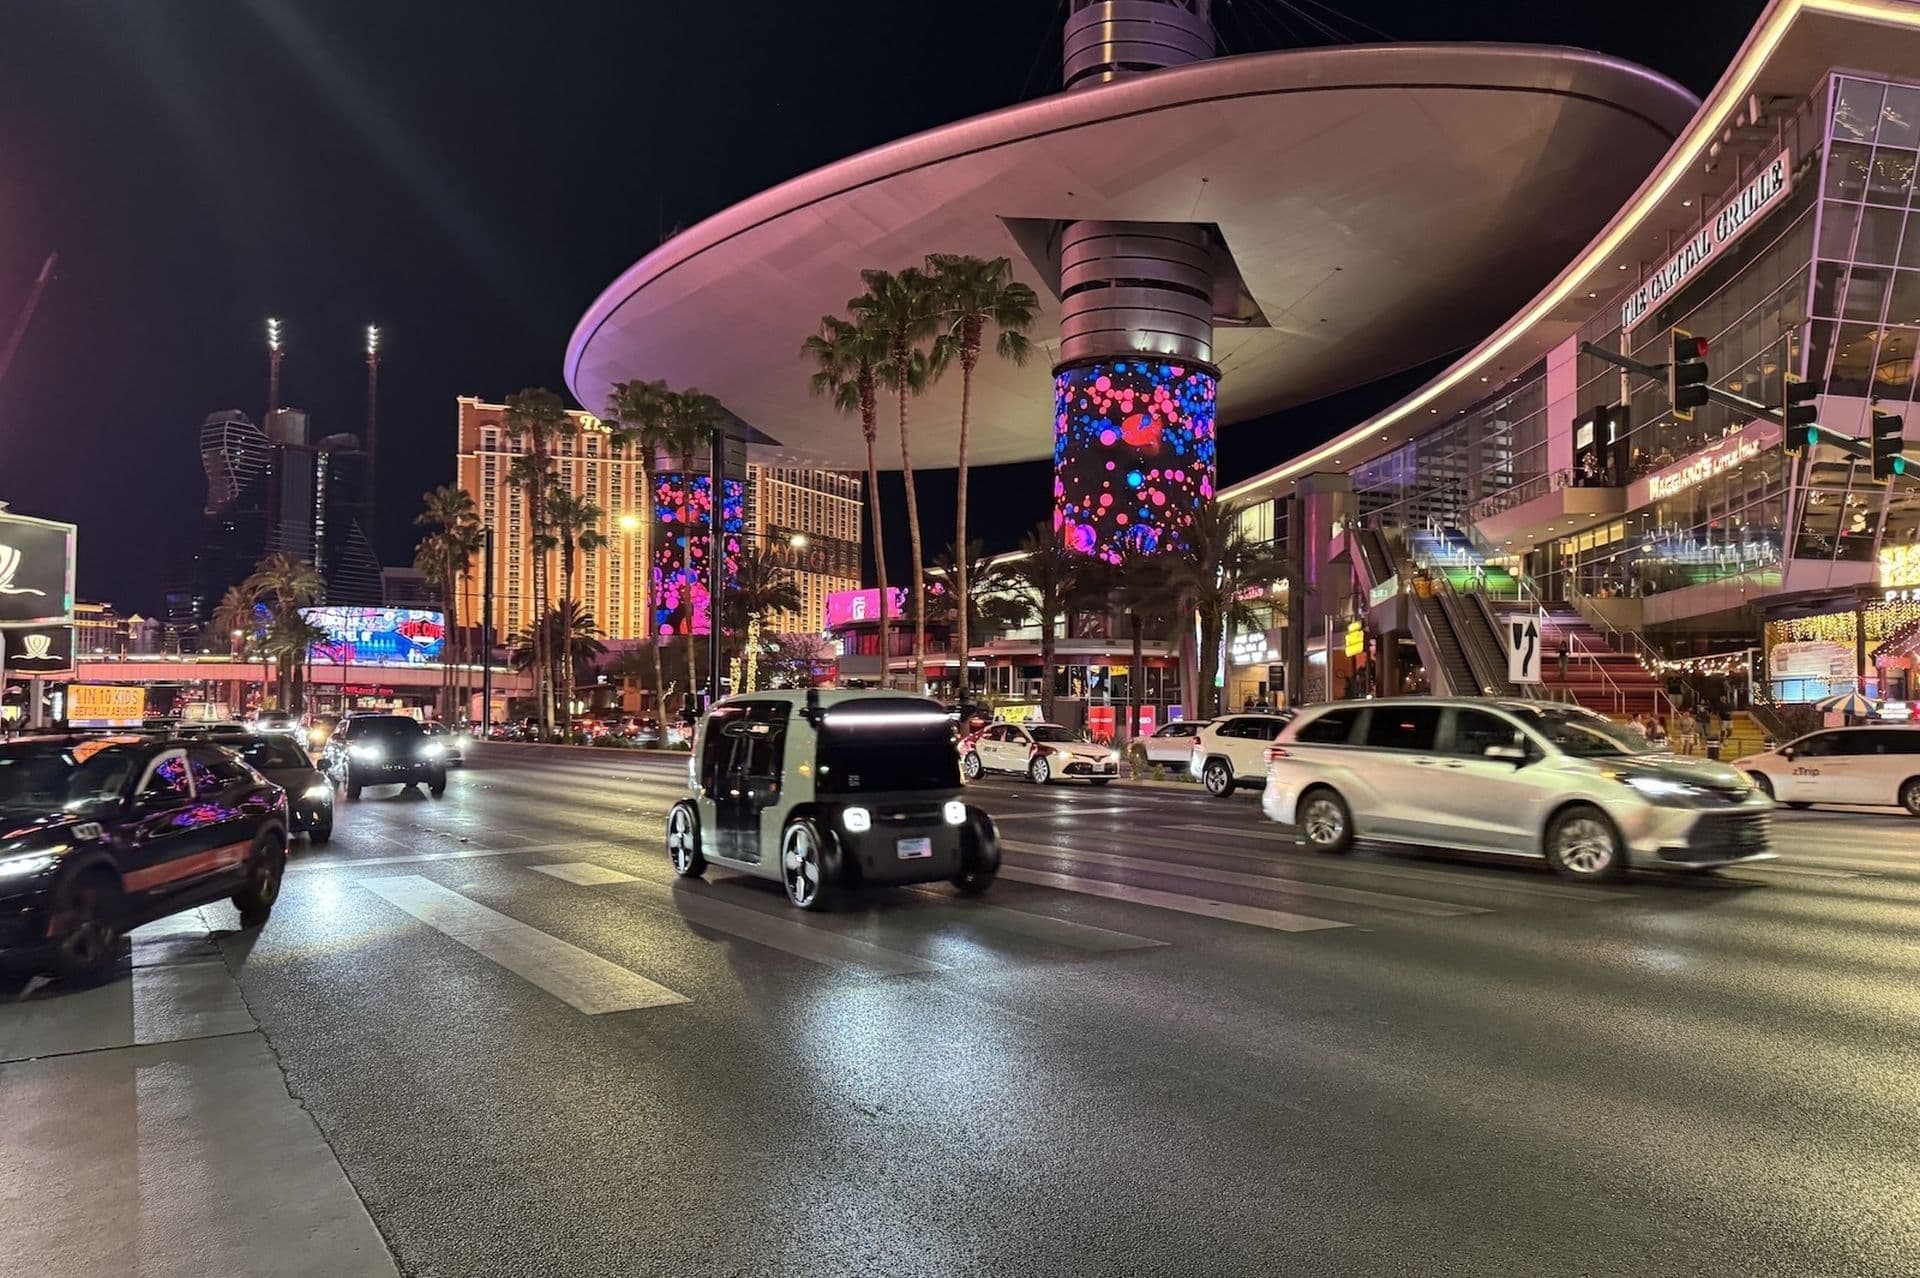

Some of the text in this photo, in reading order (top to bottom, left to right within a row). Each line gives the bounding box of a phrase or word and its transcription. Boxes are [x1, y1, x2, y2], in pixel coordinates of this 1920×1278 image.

[1622, 159, 1785, 327] THE CAPITAL GRILLE
[1792, 766, 1820, 777] zTrip
